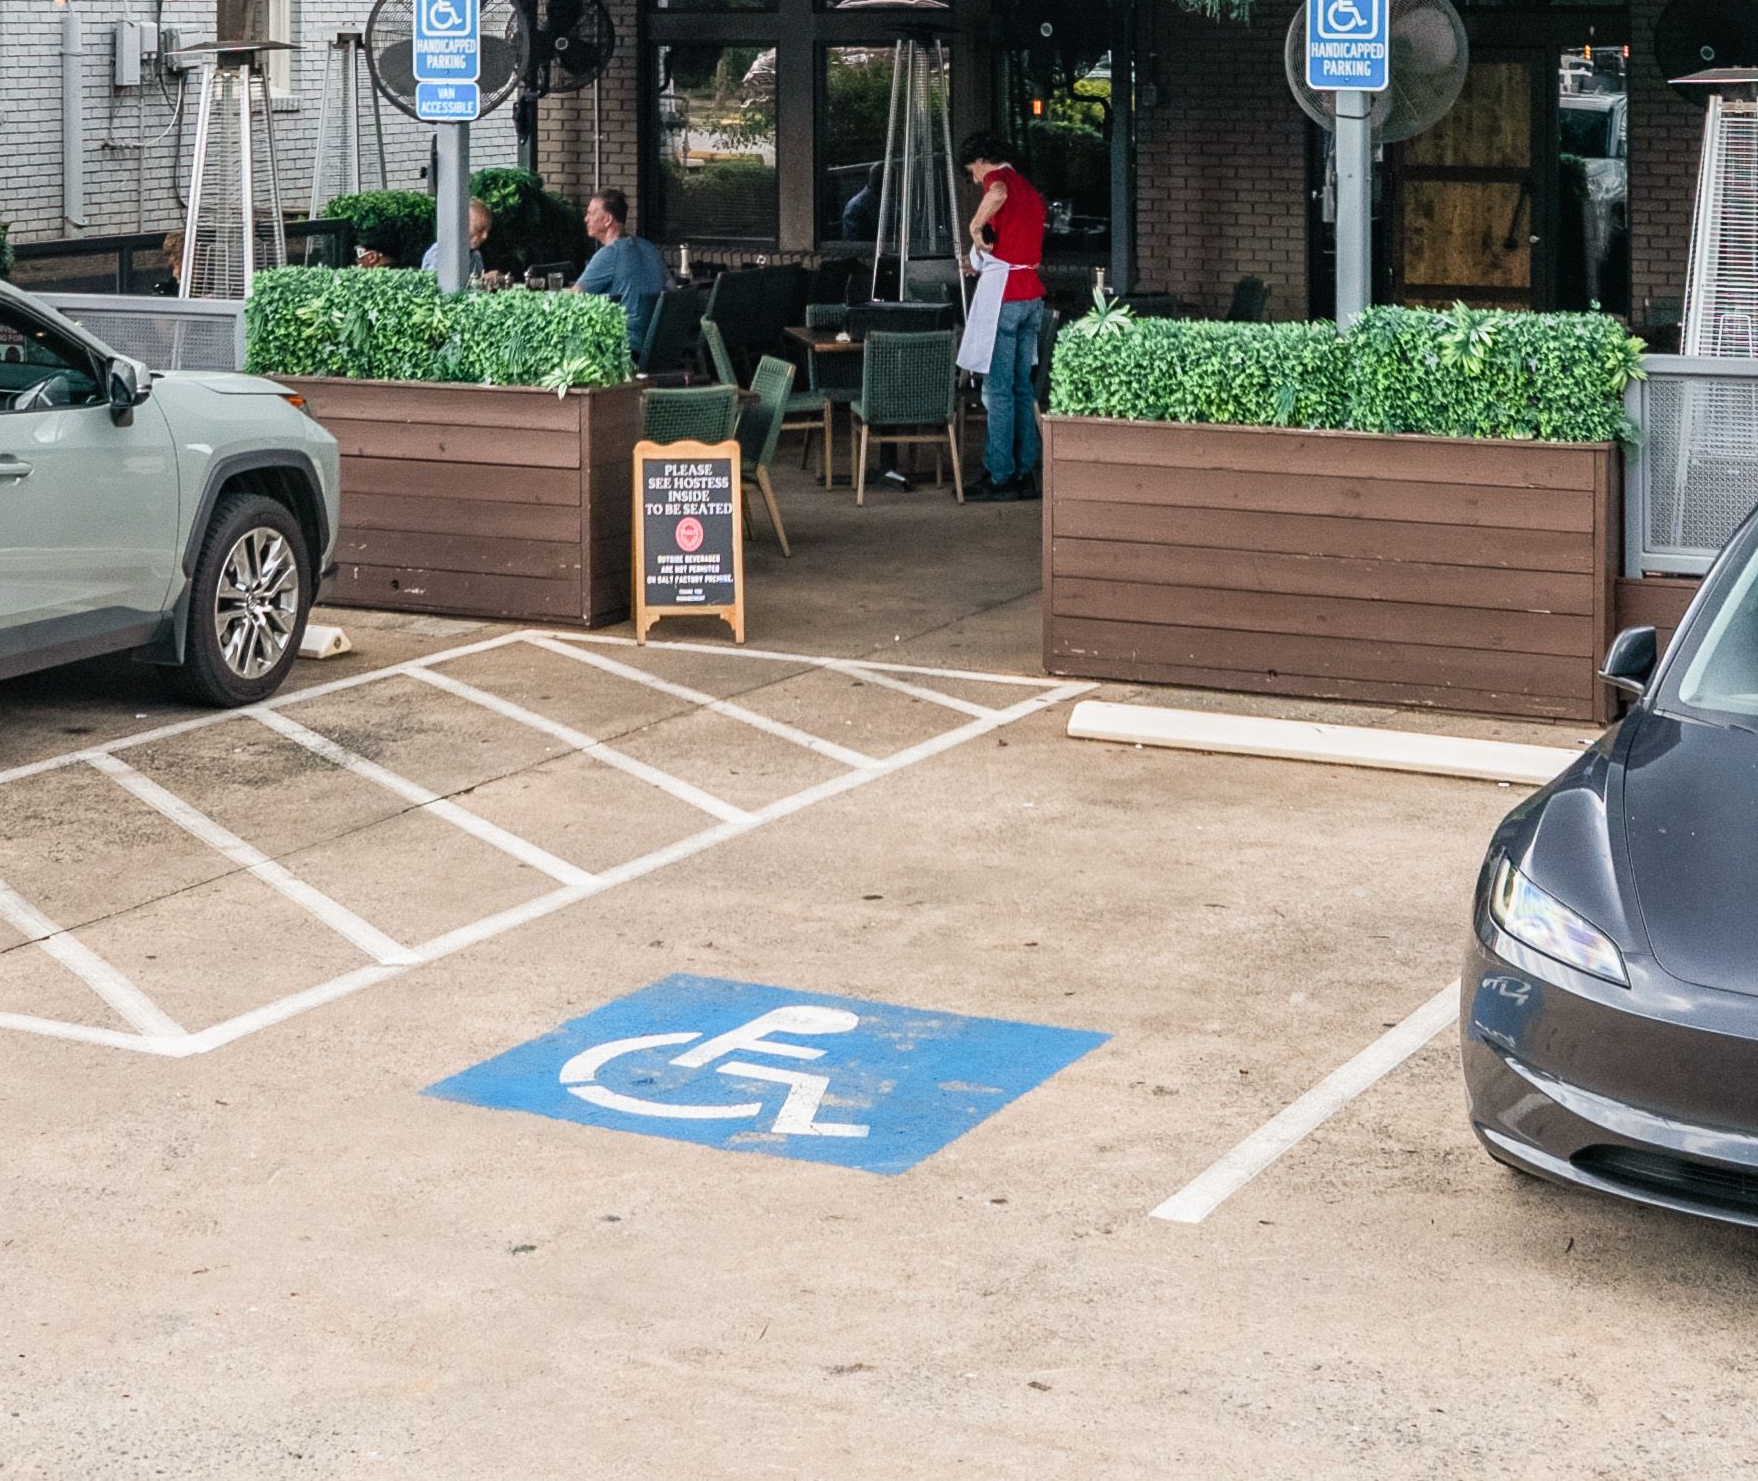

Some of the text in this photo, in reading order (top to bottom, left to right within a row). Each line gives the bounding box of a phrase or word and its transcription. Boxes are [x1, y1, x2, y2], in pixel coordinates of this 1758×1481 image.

[417, 39, 476, 53] HANDICAPPED
[1311, 42, 1384, 59] HANDICAPPED
[426, 54, 467, 69] PARKING
[1323, 60, 1372, 77] PARKING
[437, 87, 456, 99] VAN
[421, 101, 474, 113] ACCESSIBLE
[664, 464, 713, 476] PLEASE
[648, 476, 729, 490] SEE HOSTESS
[668, 490, 710, 502] INSIDE
[645, 502, 733, 516] TO BE SEATED
[657, 575, 673, 584] SALT
[675, 575, 703, 584] FACTORY
